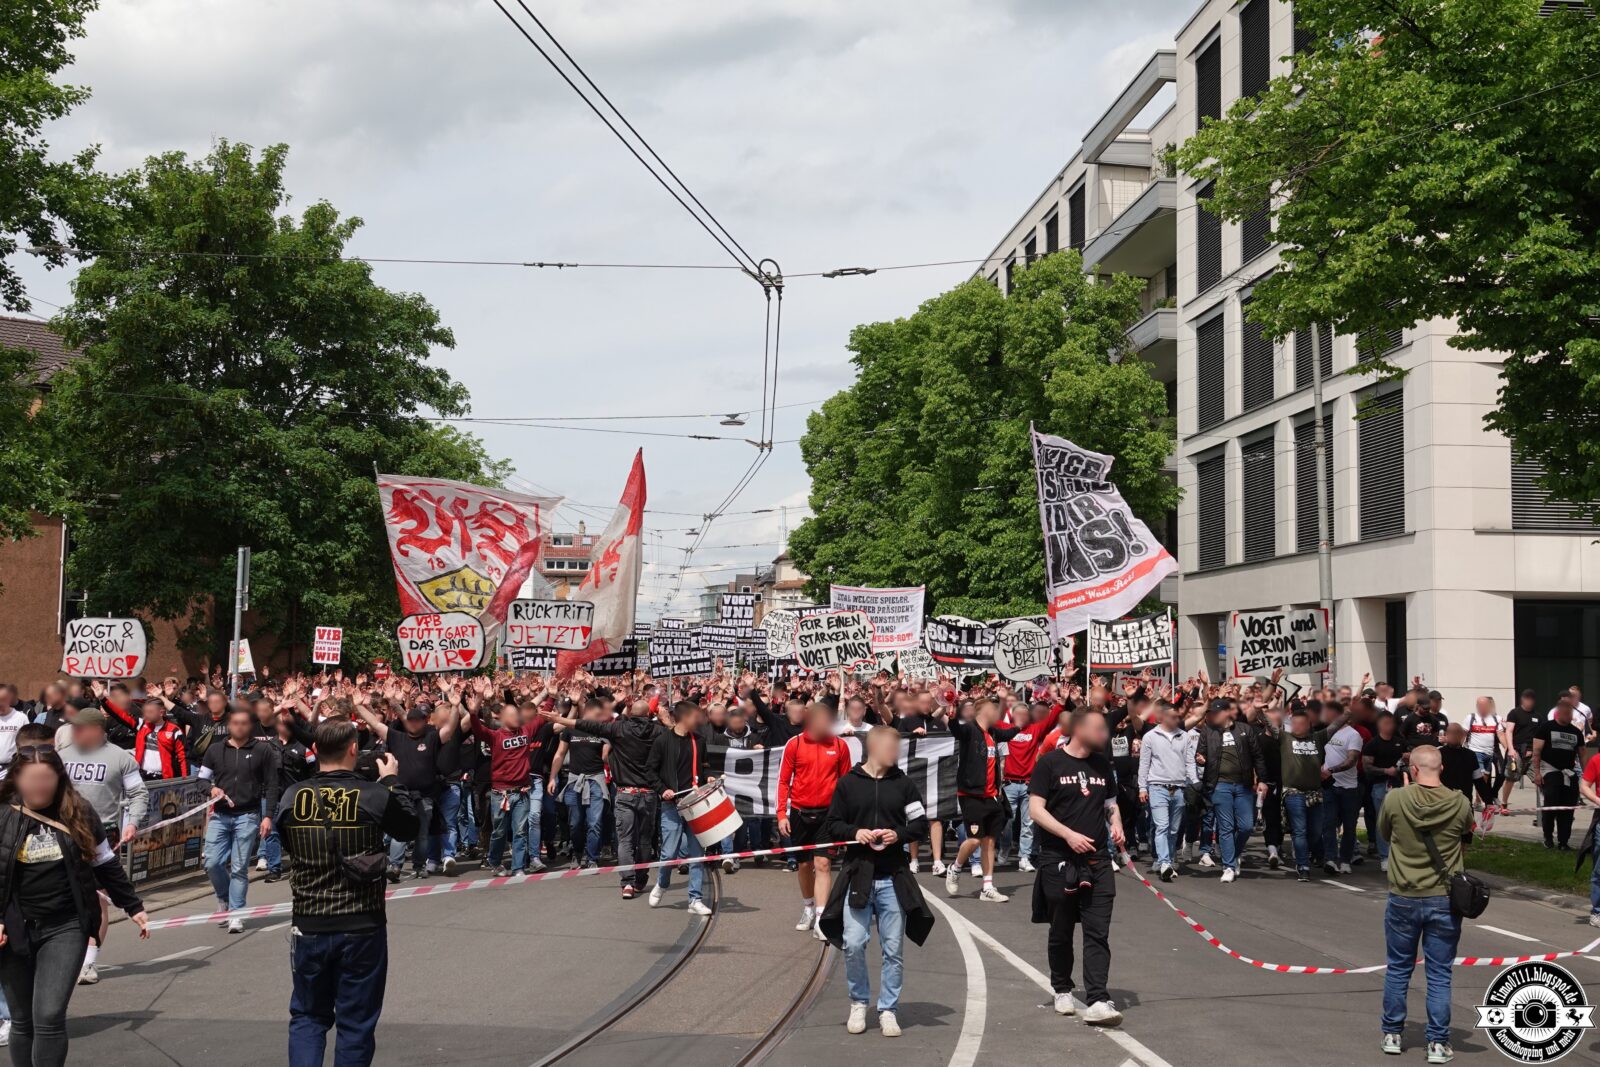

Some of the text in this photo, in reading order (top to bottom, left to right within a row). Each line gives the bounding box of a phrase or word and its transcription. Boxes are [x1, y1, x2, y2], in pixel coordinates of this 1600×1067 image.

[428, 557, 446, 571] 18
[723, 594, 754, 605] VOGT
[853, 595, 879, 604] WELCHE
[722, 606, 753, 618] UND
[70, 621, 134, 639] VOGT &
[827, 614, 860, 630] EINEN
[876, 625, 896, 633] FANS!
[1091, 614, 1169, 641] ULTRAS
[1240, 613, 1316, 637] VOGT und
[399, 625, 478, 640] STUTTGART
[509, 624, 591, 646] JETZT!
[799, 629, 850, 648] STARKEN
[975, 627, 996, 645] IS
[409, 638, 470, 651] DAS SIND
[653, 644, 691, 655] MAUL
[1091, 633, 1171, 653] BEDEUTET
[1240, 634, 1297, 657] ADRION
[315, 651, 339, 662] WIR
[651, 655, 664, 664] DU
[800, 647, 832, 668] VOGT
[836, 641, 874, 663] RAUS!
[66, 654, 139, 676] RAUS!
[652, 661, 711, 677] SCHLANGE
[1238, 655, 1273, 673] ZEIT
[1273, 656, 1289, 669] ZU
